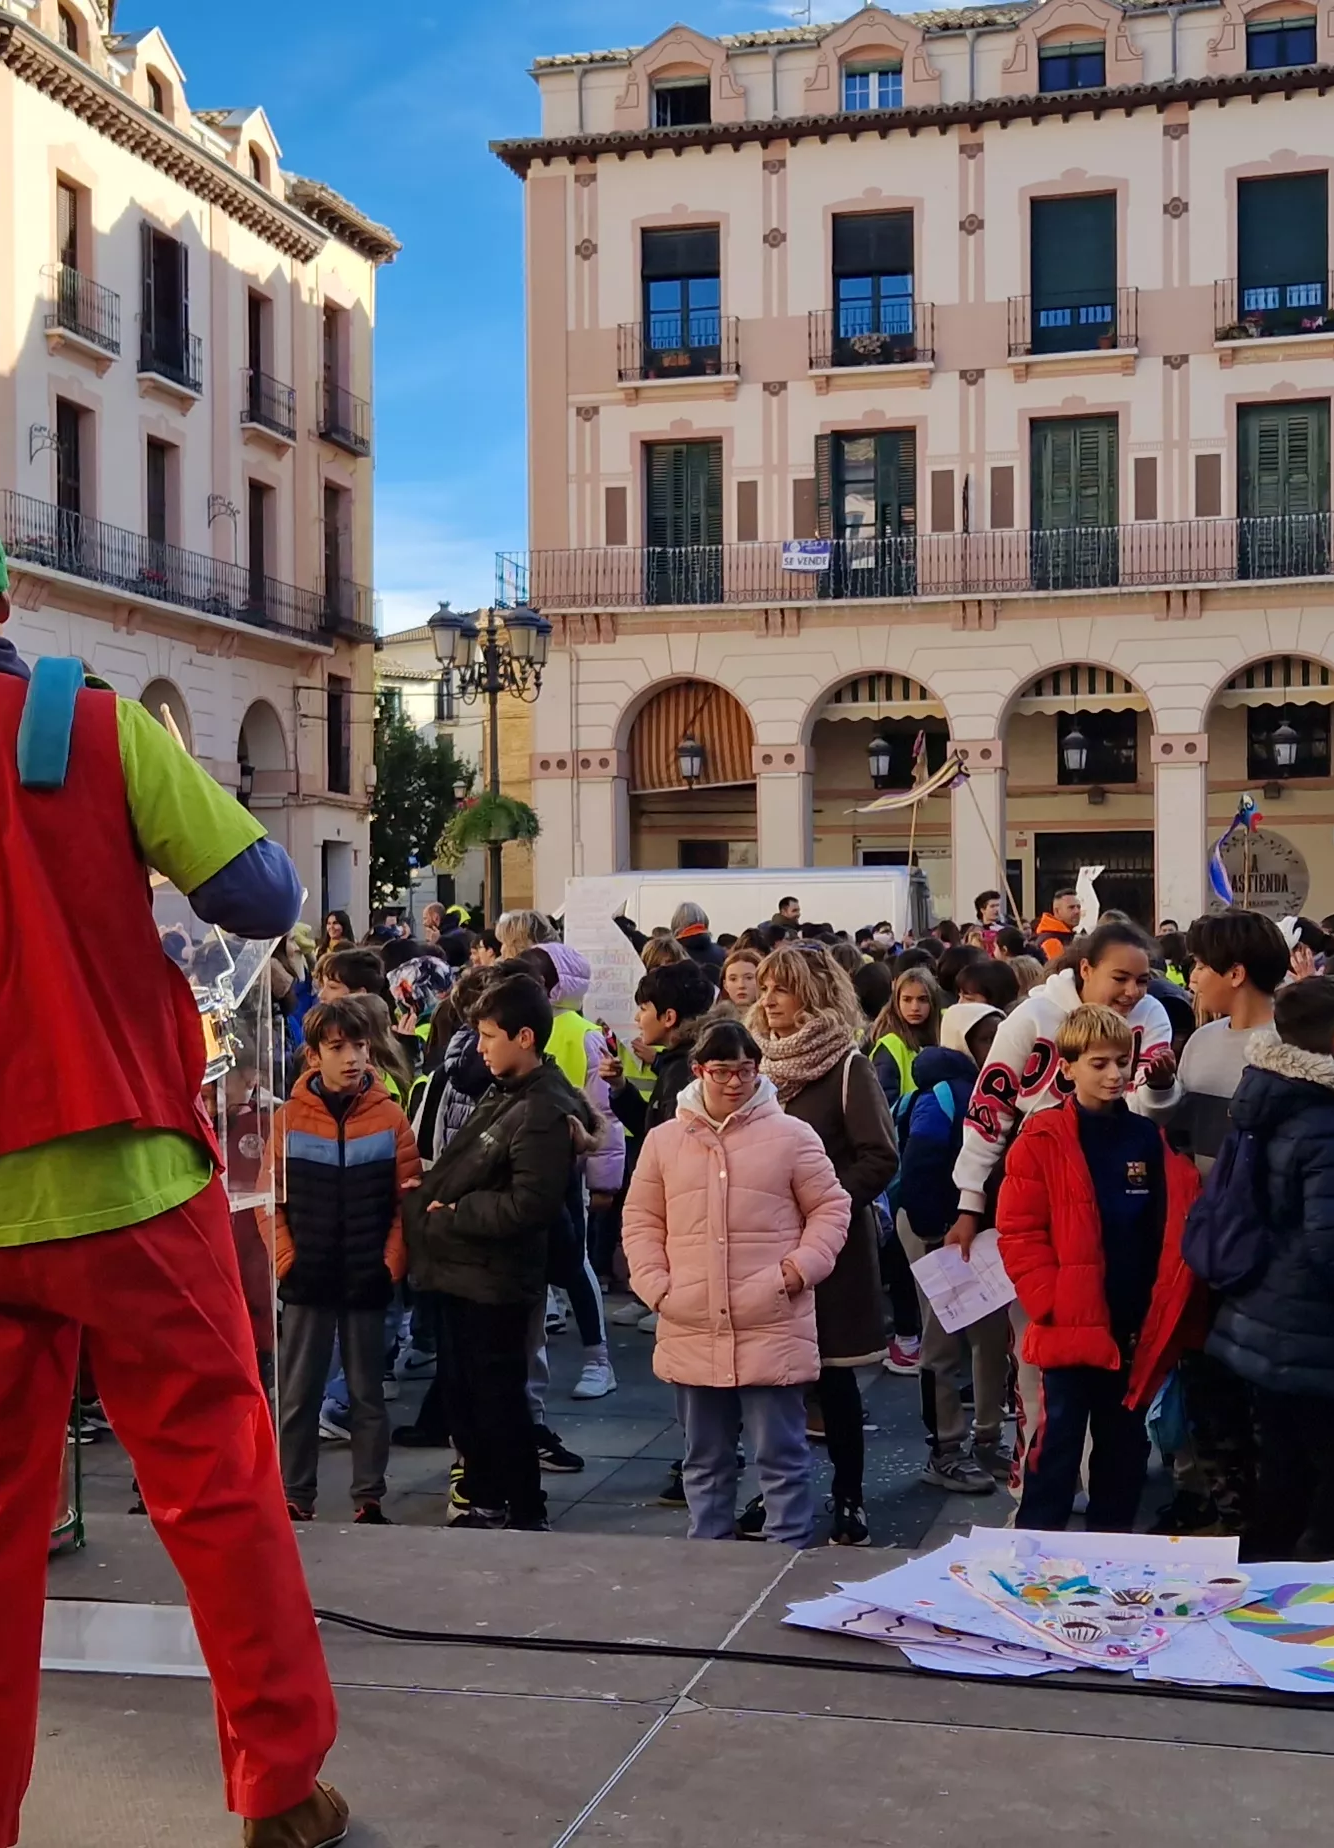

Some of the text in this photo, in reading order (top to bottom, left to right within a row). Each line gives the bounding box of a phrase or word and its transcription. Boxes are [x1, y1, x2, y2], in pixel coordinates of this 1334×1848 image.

[784, 556, 827, 566] SE VENDE
[1231, 873, 1290, 894] ASTIENDA
